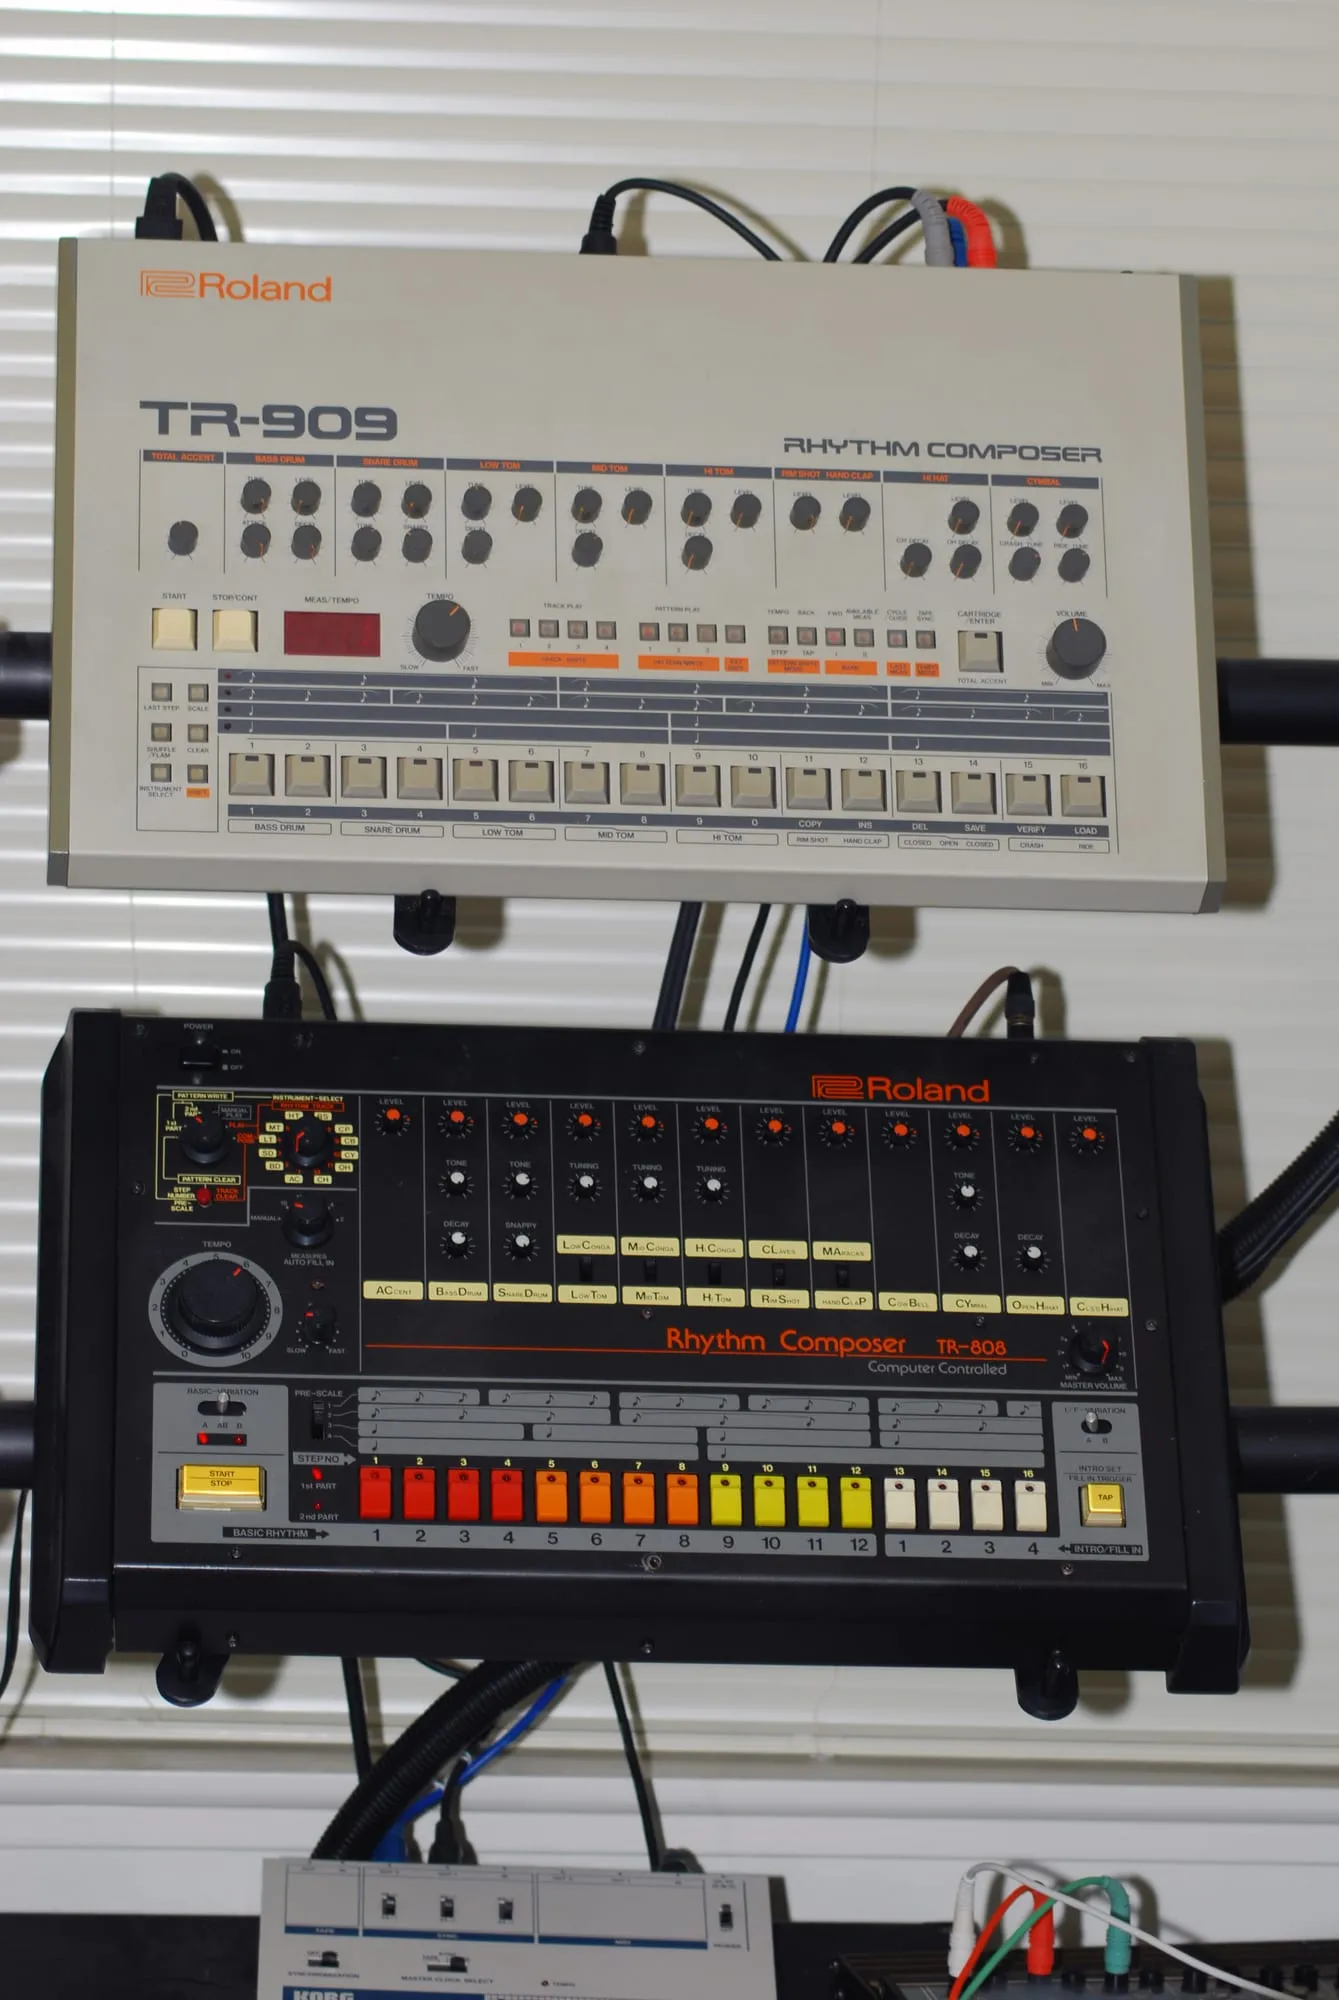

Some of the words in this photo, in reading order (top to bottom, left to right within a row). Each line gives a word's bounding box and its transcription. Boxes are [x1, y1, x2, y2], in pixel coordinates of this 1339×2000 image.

[199, 272, 331, 302] Roland
[139, 400, 397, 441] TR-909
[784, 437, 919, 457] RHYTHM
[927, 442, 1103, 463] COMPOSER
[152, 452, 177, 461] TOTAL
[181, 453, 215, 462] ACCENT
[255, 455, 278, 464] BASS
[280, 455, 305, 464] DRUM
[393, 459, 418, 468] DRUM
[480, 461, 498, 469] LOW
[502, 462, 520, 470] TOM
[609, 465, 628, 473] TOM
[704, 467, 712, 475] HI
[714, 468, 734, 476] TOM
[305, 596, 360, 604] MEAS/TEMPO
[1024, 761, 1033, 769] 15
[1079, 762, 1088, 770] 16
[280, 824, 305, 832] DRUM
[799, 820, 822, 828] COPY
[912, 823, 928, 831] DEL
[364, 826, 392, 834] SNARE
[1017, 826, 1046, 834] VERIFY
[1074, 827, 1097, 835] LOAD
[868, 1076, 990, 1103] Roland
[666, 1328, 766, 1355] Rhythm
[780, 1329, 906, 1358] Composer
[936, 1339, 1007, 1356] TR-808
[868, 1360, 935, 1376] Computer
[938, 1362, 1007, 1375] Controlled
[1094, 1382, 1128, 1390] VOLUME
[298, 1455, 323, 1463] STEP
[461, 1458, 467, 1466] 3
[504, 1459, 511, 1467] 4
[548, 1460, 555, 1468] 5
[591, 1461, 598, 1469] 6
[636, 1462, 642, 1470] 7
[722, 1463, 729, 1471] 9
[762, 1464, 773, 1472] 10
[808, 1465, 817, 1473] 11
[851, 1466, 861, 1474] 12
[894, 1467, 905, 1476] 13
[937, 1468, 948, 1476] 14
[980, 1469, 990, 1477] 15
[1023, 1470, 1033, 1478] 16
[233, 1529, 264, 1537] BASIC
[265, 1529, 308, 1537] RHYTHM
[373, 1529, 380, 1541] 1
[415, 1530, 426, 1542] 2
[459, 1531, 470, 1543] 3
[503, 1532, 514, 1544] 4
[547, 1533, 558, 1545] 5
[591, 1533, 602, 1545] 6
[636, 1534, 646, 1547] 7
[679, 1535, 690, 1547] 8
[723, 1536, 734, 1548] 9
[762, 1537, 781, 1550] 10
[808, 1538, 822, 1550] 11
[851, 1539, 868, 1551] 12
[899, 1541, 906, 1552] 1
[941, 1541, 952, 1553] 2
[984, 1542, 995, 1554] 3
[1028, 1542, 1038, 1555] 4
[1074, 1545, 1128, 1554] INTRO/FILL
[1131, 1546, 1141, 1554] IN
